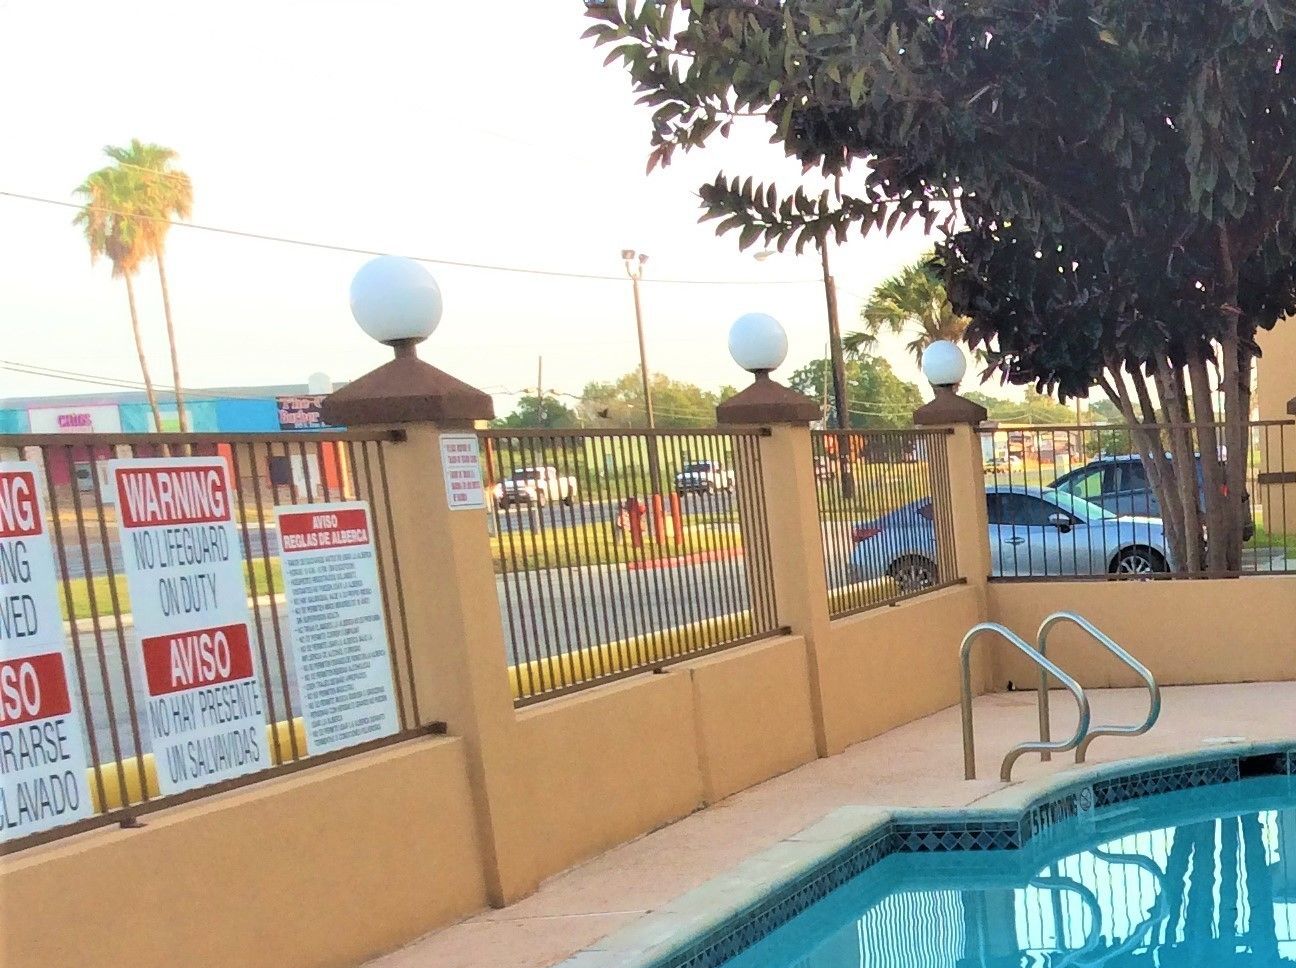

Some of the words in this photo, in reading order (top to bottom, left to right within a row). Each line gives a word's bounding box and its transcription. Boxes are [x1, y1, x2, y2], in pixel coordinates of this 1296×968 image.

[122, 470, 226, 522] WARNING
[283, 532, 318, 549] REGLAS
[318, 531, 331, 546] DE
[331, 528, 368, 545] ALBERCA
[312, 514, 338, 530] AVISO
[132, 530, 154, 570] NO
[156, 525, 229, 568] LIFEGUARD
[159, 577, 180, 616] ON
[180, 573, 217, 613] DUTY
[170, 631, 231, 687] AVISO
[149, 698, 170, 738] NO
[170, 693, 196, 734] HAY
[198, 680, 261, 728] PRESENTE
[166, 743, 187, 783] UN
[187, 726, 260, 778] SALVAVIDAS
